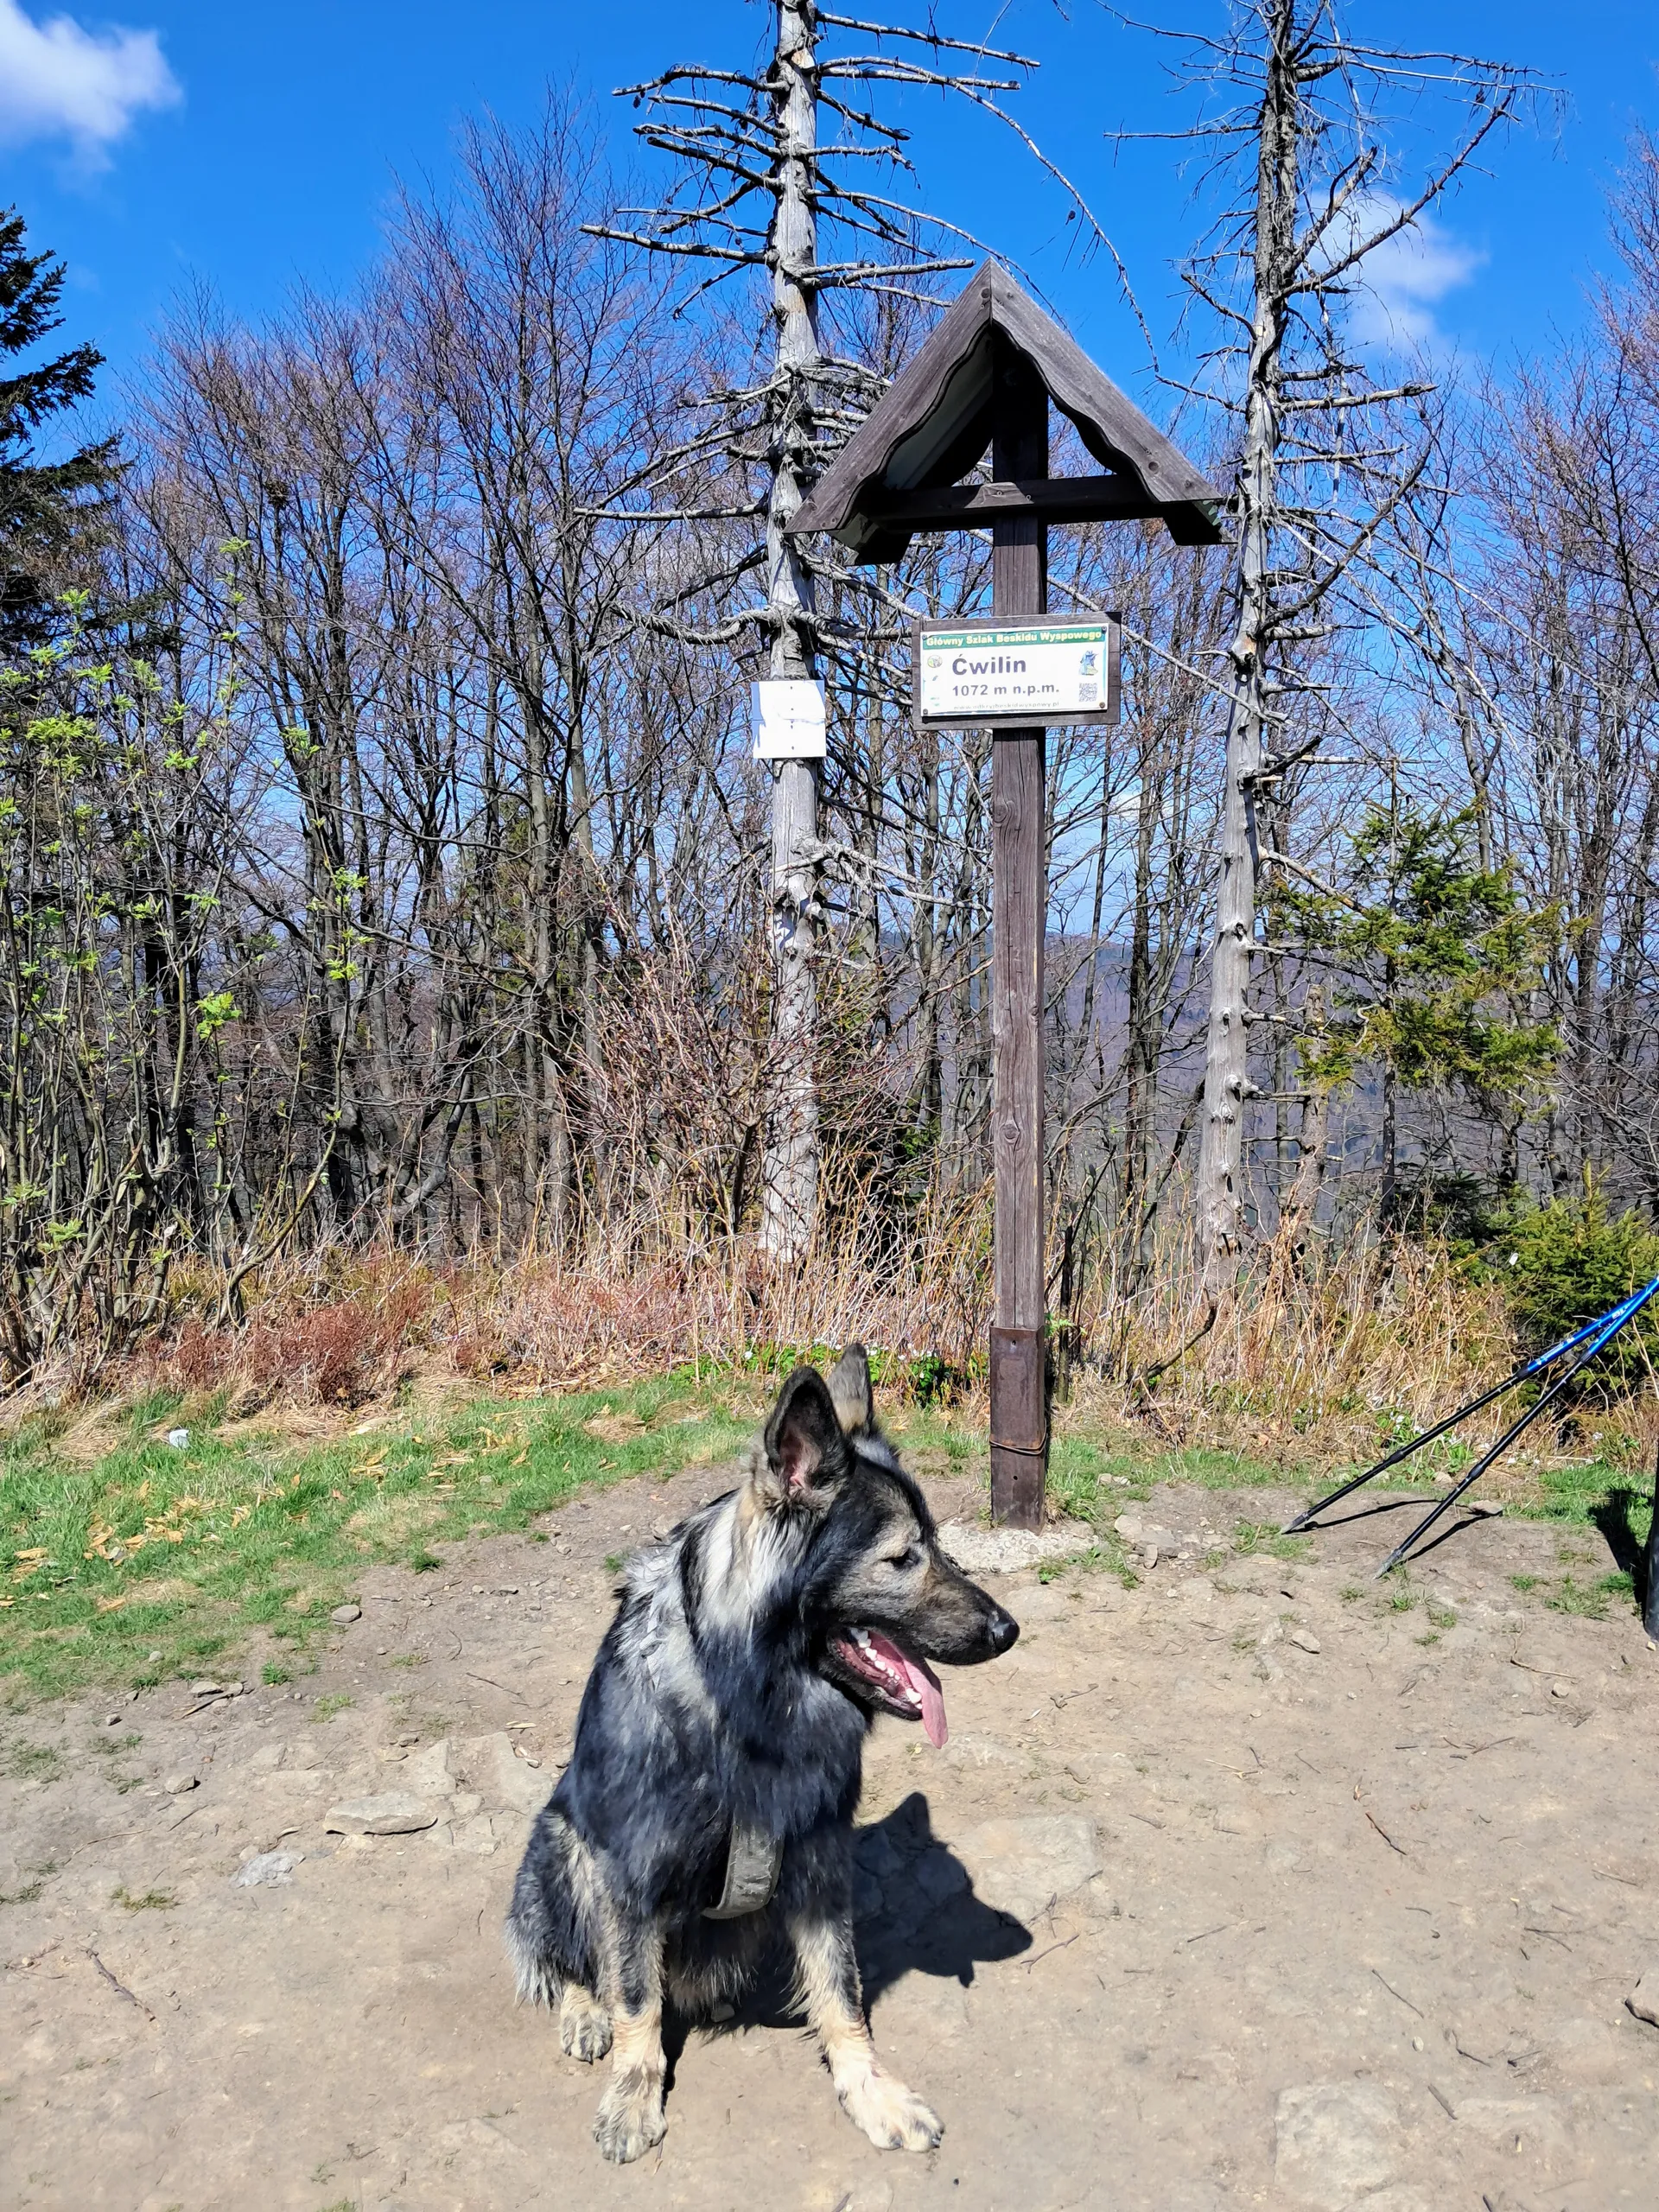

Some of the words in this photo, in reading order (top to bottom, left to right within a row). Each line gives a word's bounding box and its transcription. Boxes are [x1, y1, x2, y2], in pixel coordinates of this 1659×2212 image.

[926, 636, 963, 646] Główny
[966, 634, 993, 644] Szlak
[996, 632, 1037, 643] Beskidu
[1039, 631, 1102, 642] Wyspowego
[952, 653, 1027, 675] Ćwilin
[952, 684, 988, 696] 1072
[994, 686, 1007, 695] m
[1013, 684, 1059, 696] n.p.m.
